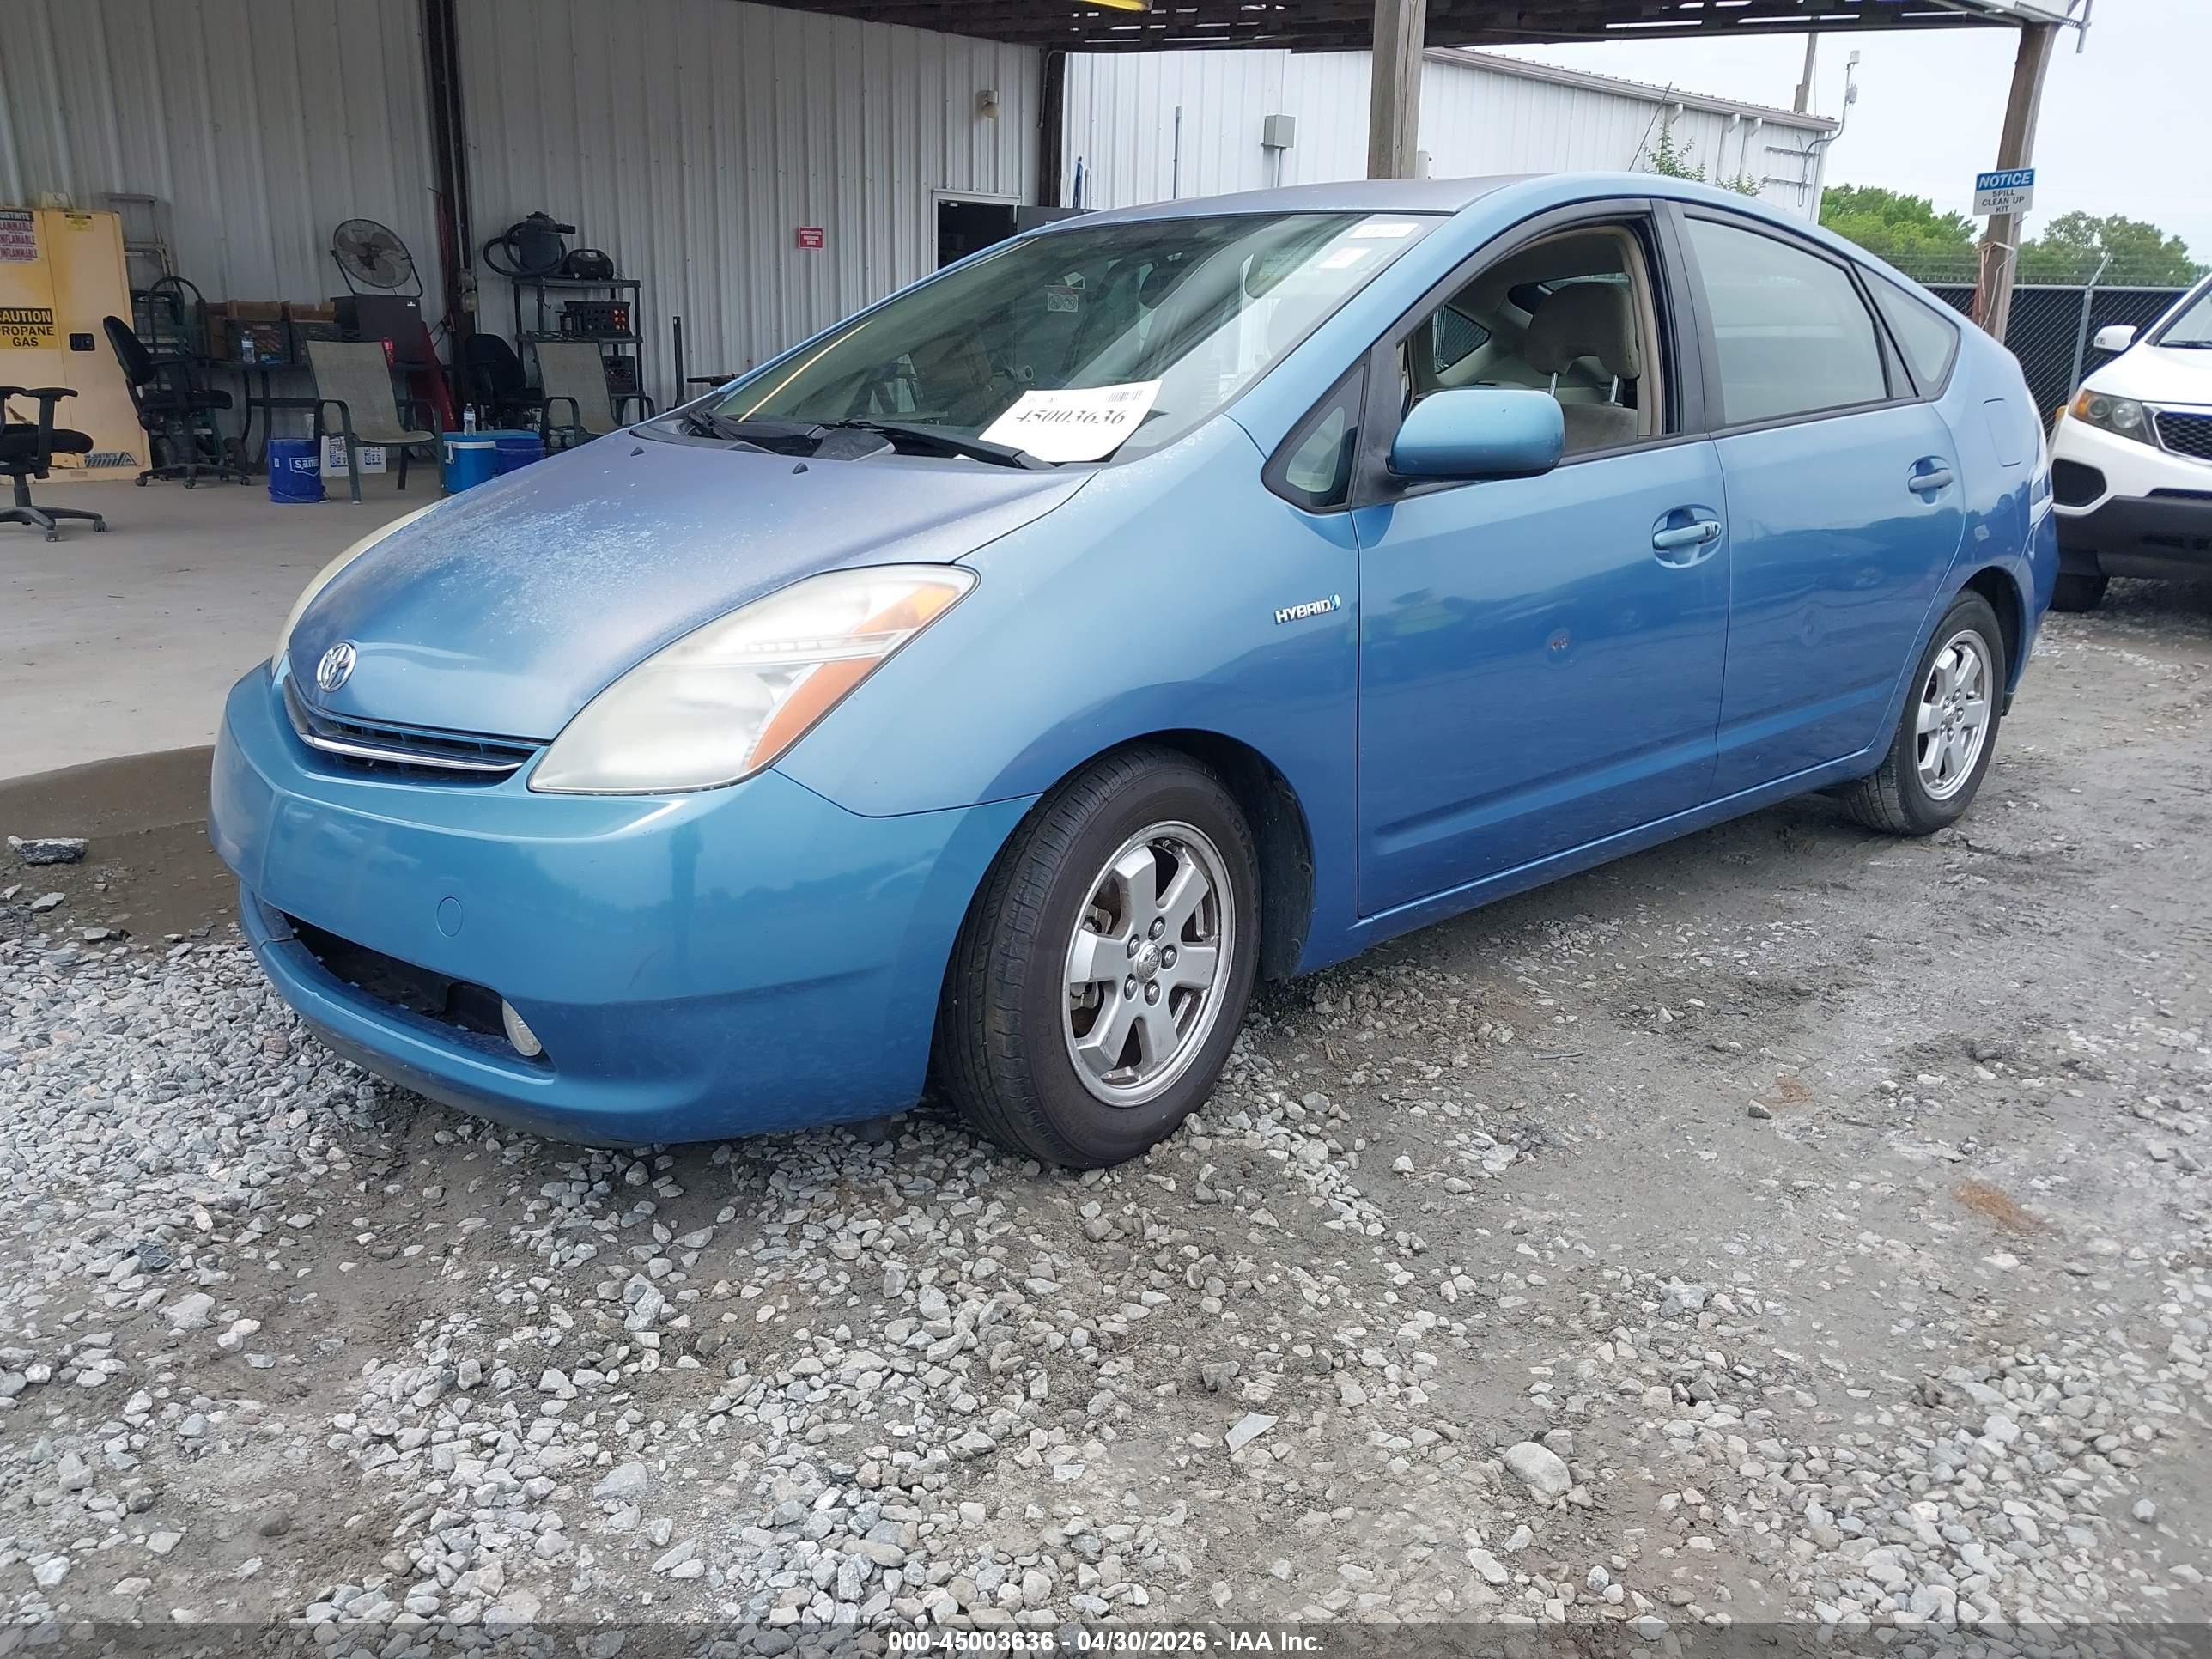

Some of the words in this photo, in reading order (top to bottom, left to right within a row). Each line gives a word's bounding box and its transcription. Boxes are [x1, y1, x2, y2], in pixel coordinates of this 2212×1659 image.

[1979, 172, 2033, 188] NOTICE
[1992, 189, 2014, 198] SPILL
[1981, 198, 2009, 207] CLEAN
[2012, 196, 2025, 204] UP
[1996, 205, 2009, 214] KIT
[0, 222, 34, 232] LAMMABLE
[0, 325, 55, 336] ROPANE
[12, 337, 39, 348] GAS
[1016, 409, 1127, 424] 45003636
[1274, 599, 1331, 625] HYBRID
